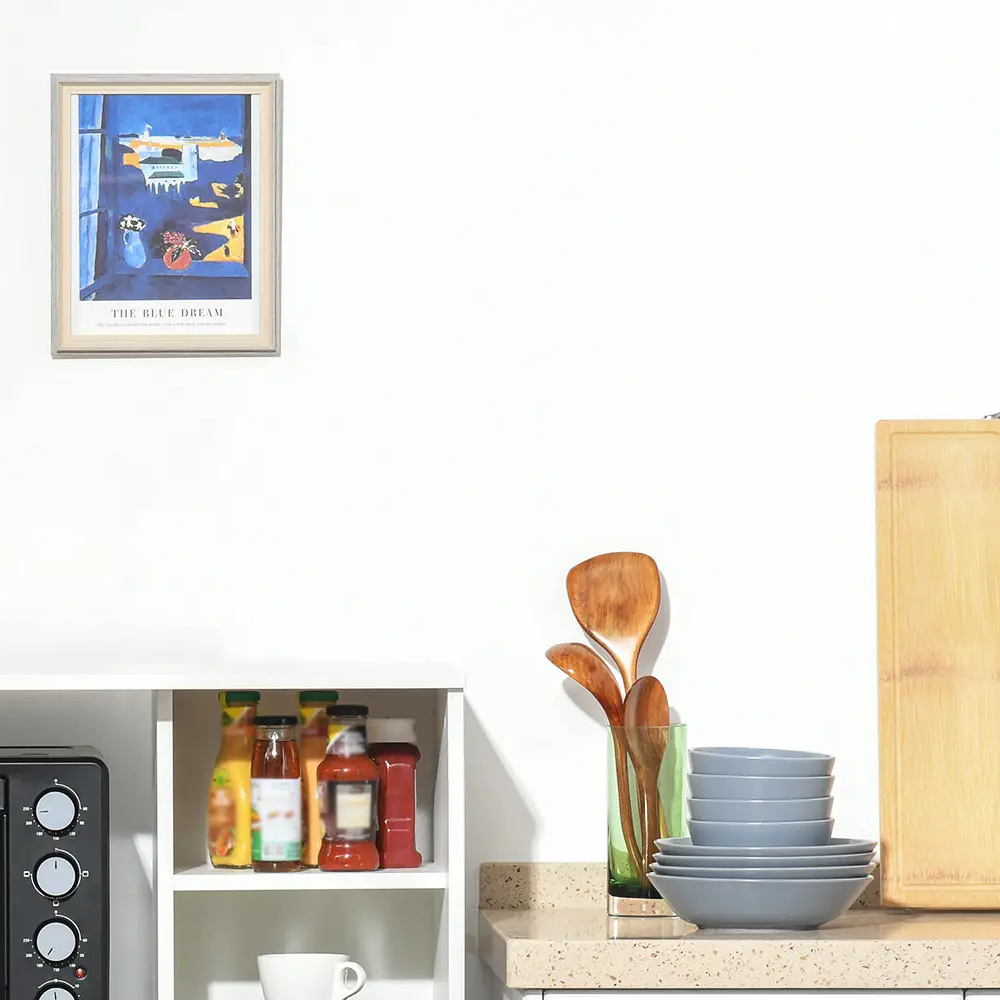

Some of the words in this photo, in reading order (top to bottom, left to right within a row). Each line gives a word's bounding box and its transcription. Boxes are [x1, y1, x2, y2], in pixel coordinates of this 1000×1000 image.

[110, 308, 137, 318] THE
[143, 308, 175, 318] BLUE
[181, 307, 223, 317] DREAM
